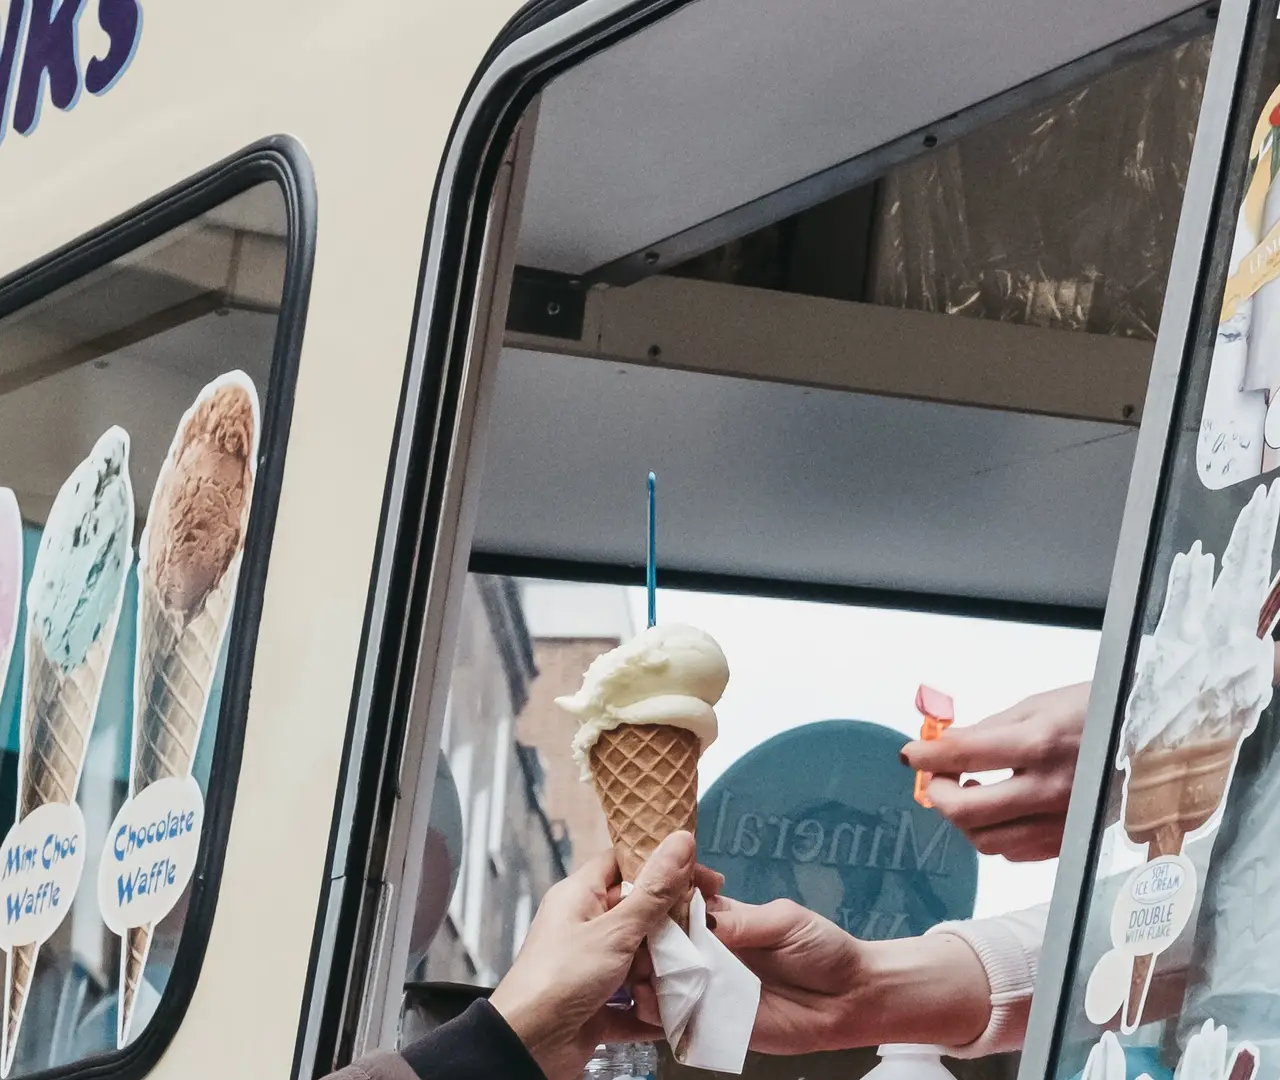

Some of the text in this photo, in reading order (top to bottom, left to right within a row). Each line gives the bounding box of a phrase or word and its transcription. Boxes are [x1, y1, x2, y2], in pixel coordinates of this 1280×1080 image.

[113, 809, 195, 863] Chocolate
[3, 831, 76, 880] Mint Choc
[1152, 864, 1170, 879] SOFT
[117, 860, 176, 907] Waffle
[1135, 875, 1180, 895] ICE CREAM
[6, 886, 60, 925] Waffle
[1128, 902, 1175, 929] DOUBLE
[1125, 922, 1173, 944] WITH FLAKE
